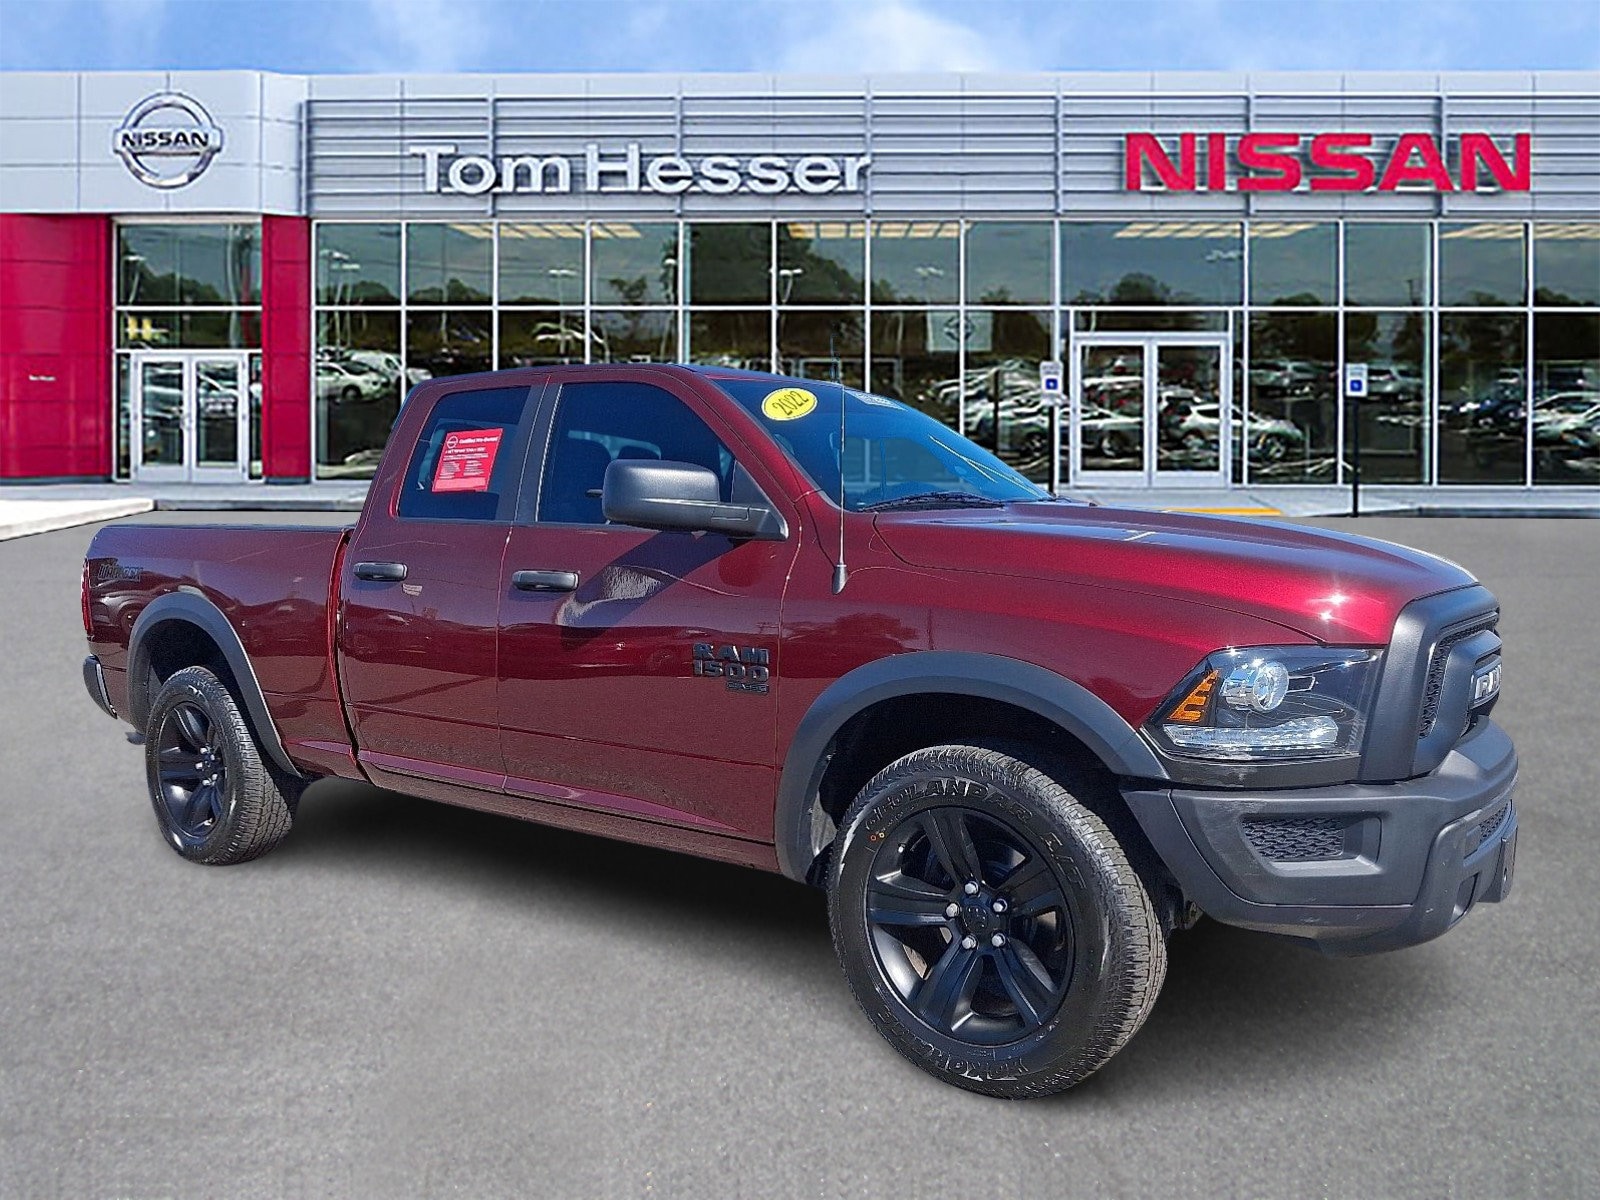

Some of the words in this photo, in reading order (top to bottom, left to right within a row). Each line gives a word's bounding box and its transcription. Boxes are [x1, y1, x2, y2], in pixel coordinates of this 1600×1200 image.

[121, 131, 209, 147] NISSAN
[409, 144, 571, 194] Tom
[585, 143, 871, 194] Hesser
[1125, 132, 1531, 191] NISSAN
[772, 390, 809, 416] 2022
[693, 642, 769, 665] RAM
[693, 659, 769, 682] 1500
